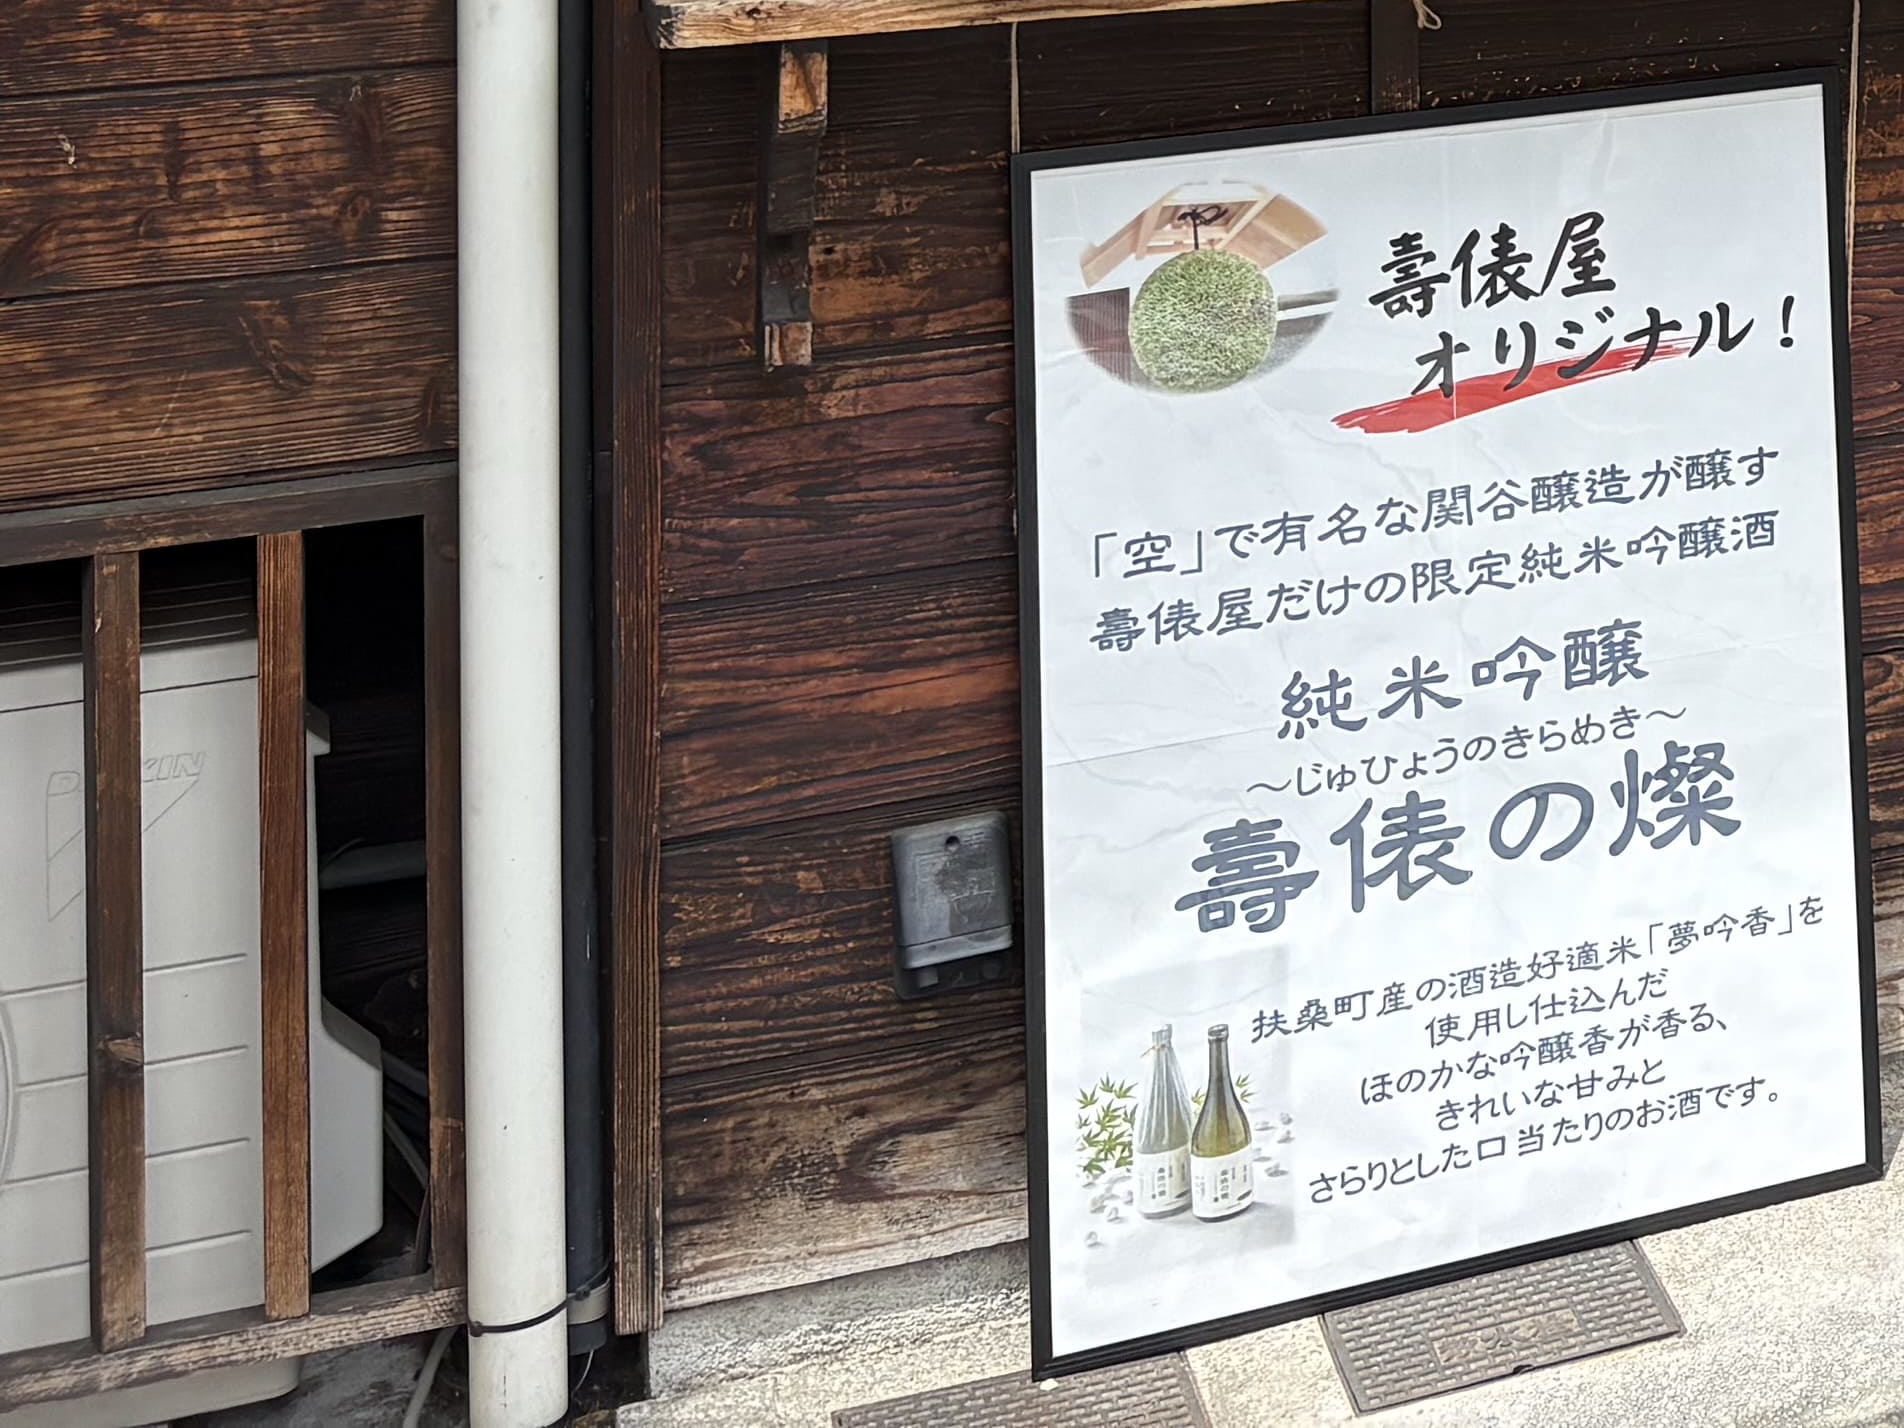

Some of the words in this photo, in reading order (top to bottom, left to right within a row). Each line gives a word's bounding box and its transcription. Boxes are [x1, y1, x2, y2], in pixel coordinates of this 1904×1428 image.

[1367, 209, 1619, 321] 壽俵屋
[1089, 444, 1781, 582] 「空」で有名な関谷醸造が醸す
[1088, 507, 1780, 656] 壽俵屋だけの限定純米吟醸酒
[1276, 616, 1651, 742] 純米吟醸
[1172, 740, 1743, 934] 壽俵の燦
[1248, 894, 1825, 1044] 扶桑町産の酒造好適米「夢吟香」を
[1423, 968, 1669, 1047] 使用し仕込んだ
[1360, 1001, 1731, 1108] ほのかな吟醸香が香る、
[1435, 1056, 1668, 1134] きれいな甘みと
[1307, 1074, 1785, 1208] さらりとした口当たりのお酒です。
